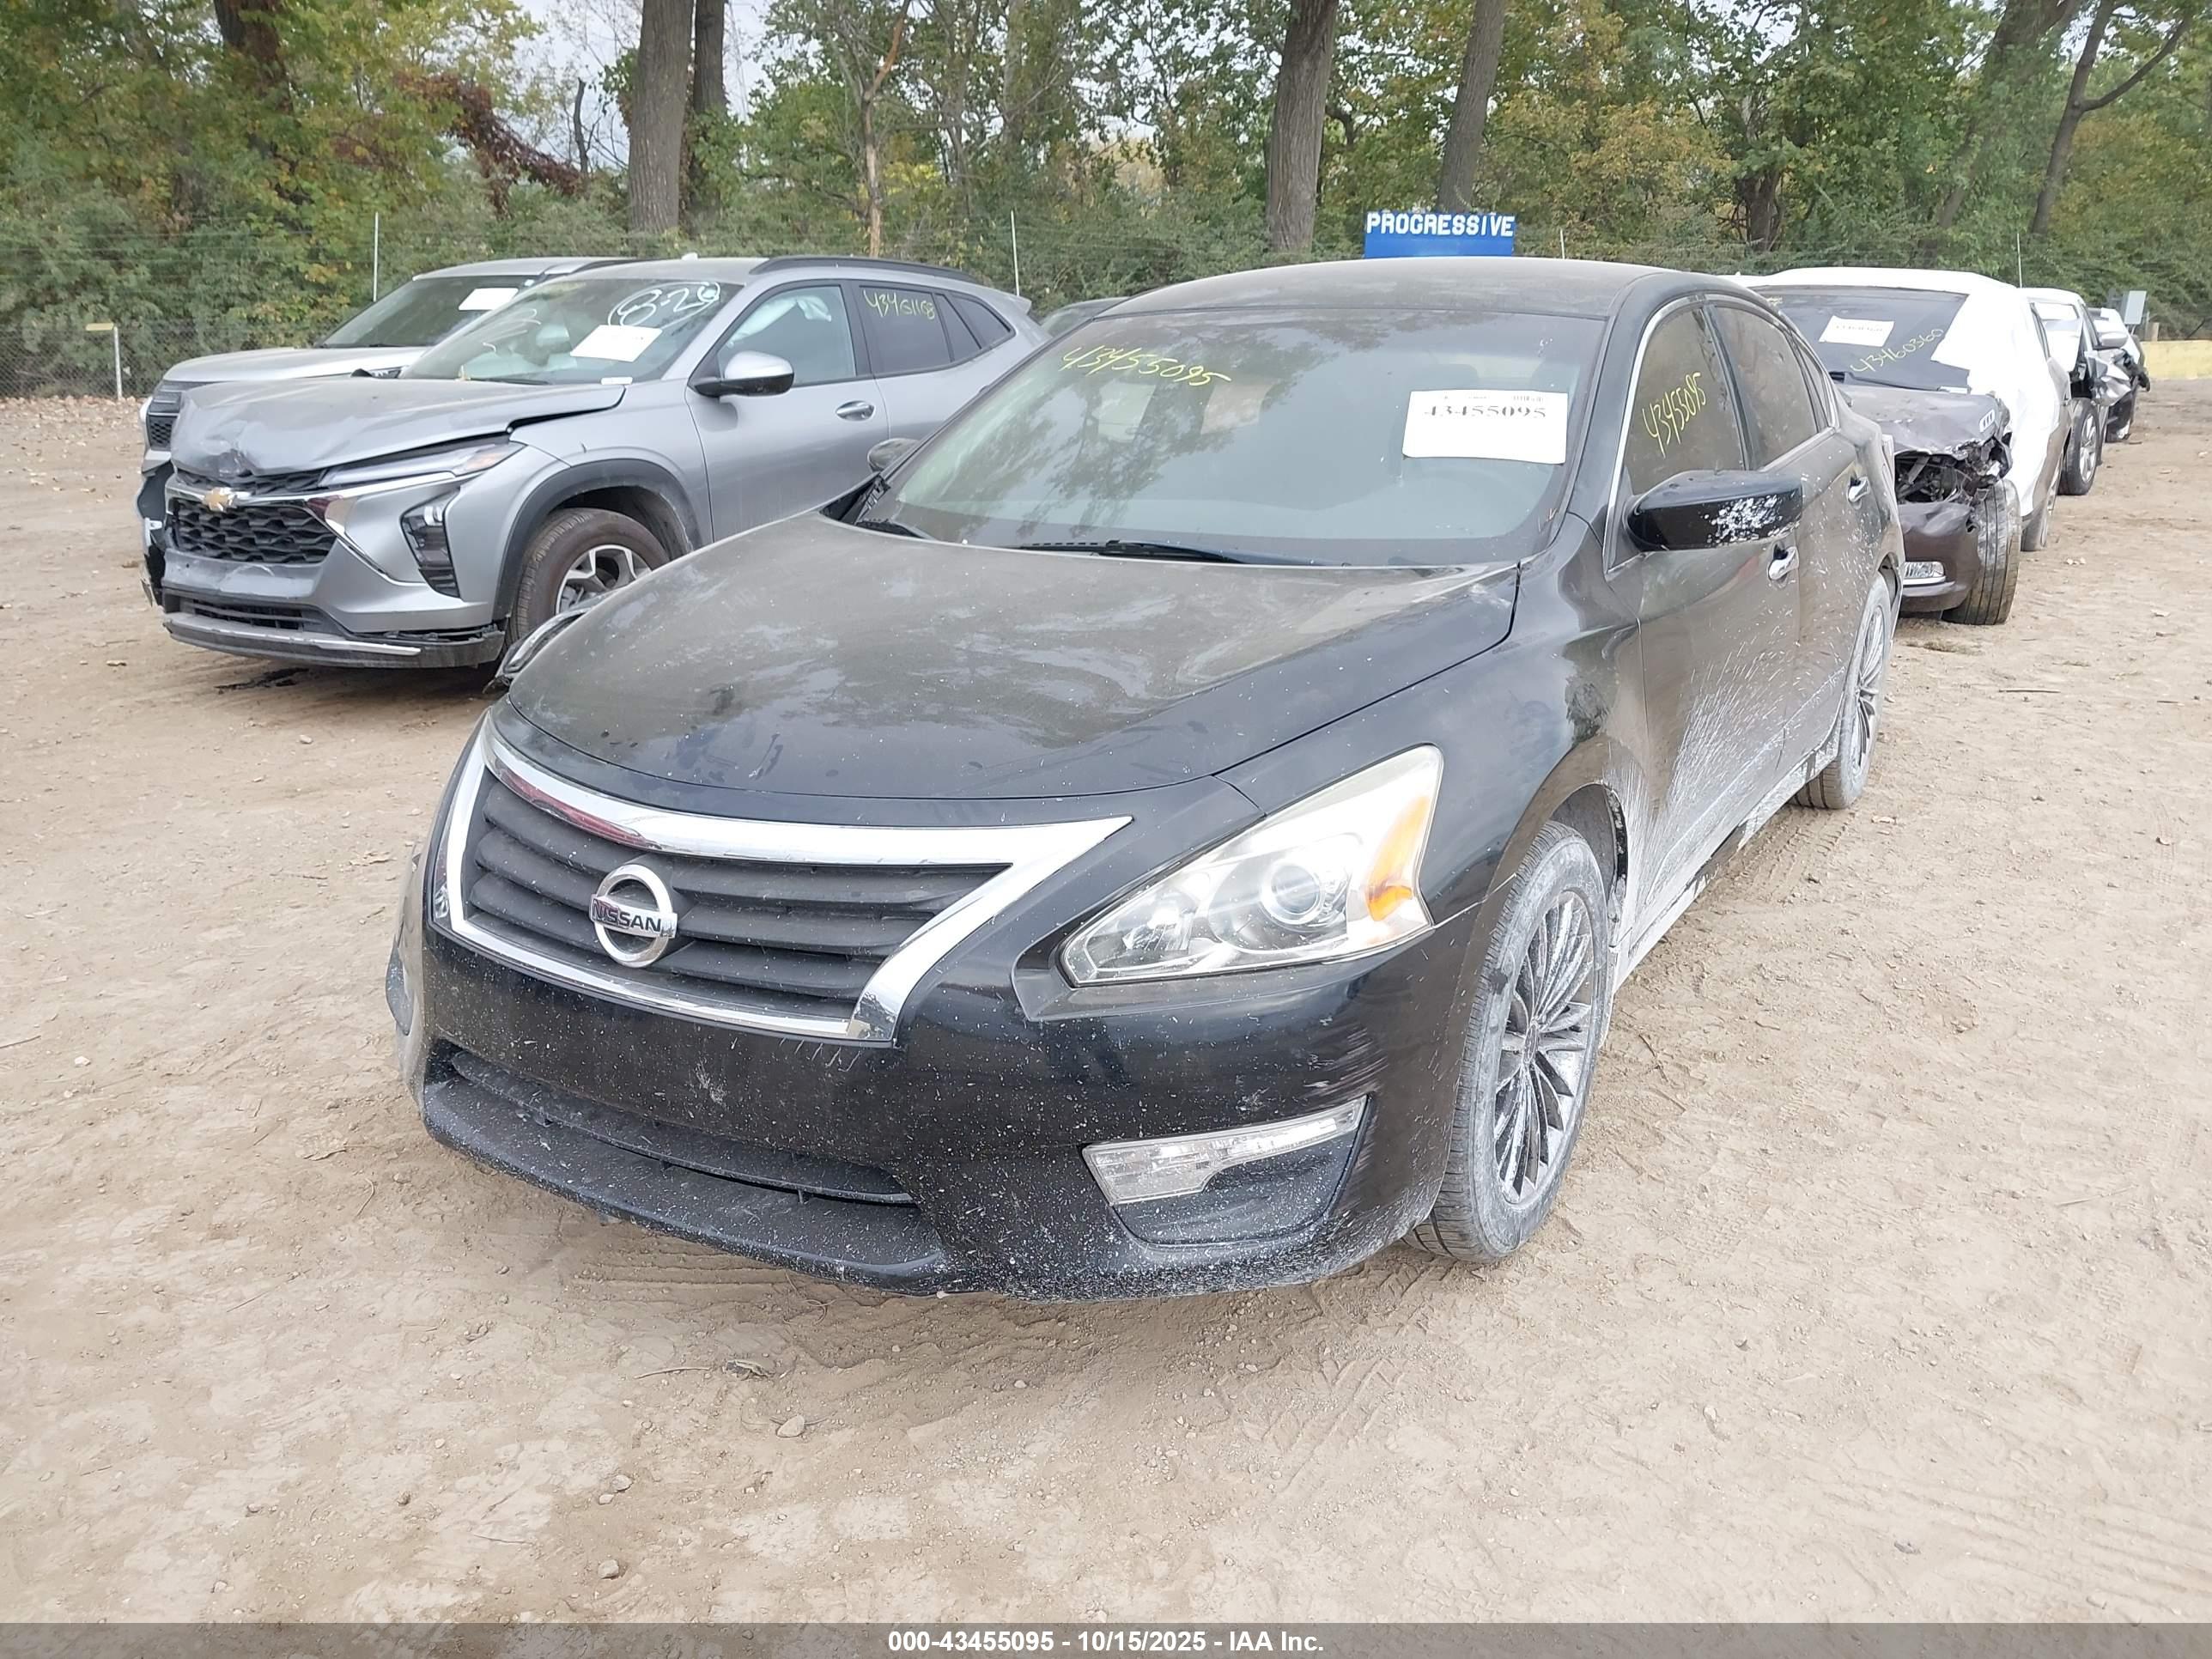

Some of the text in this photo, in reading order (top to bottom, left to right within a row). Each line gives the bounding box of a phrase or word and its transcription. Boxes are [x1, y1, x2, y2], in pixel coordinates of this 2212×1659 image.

[1366, 212, 1516, 237] PROGRESSIVE
[1058, 344, 1232, 386] 43455095
[1849, 327, 1944, 372] 43460360
[1641, 371, 1707, 460] 43455095
[592, 897, 661, 933] NISSAN
